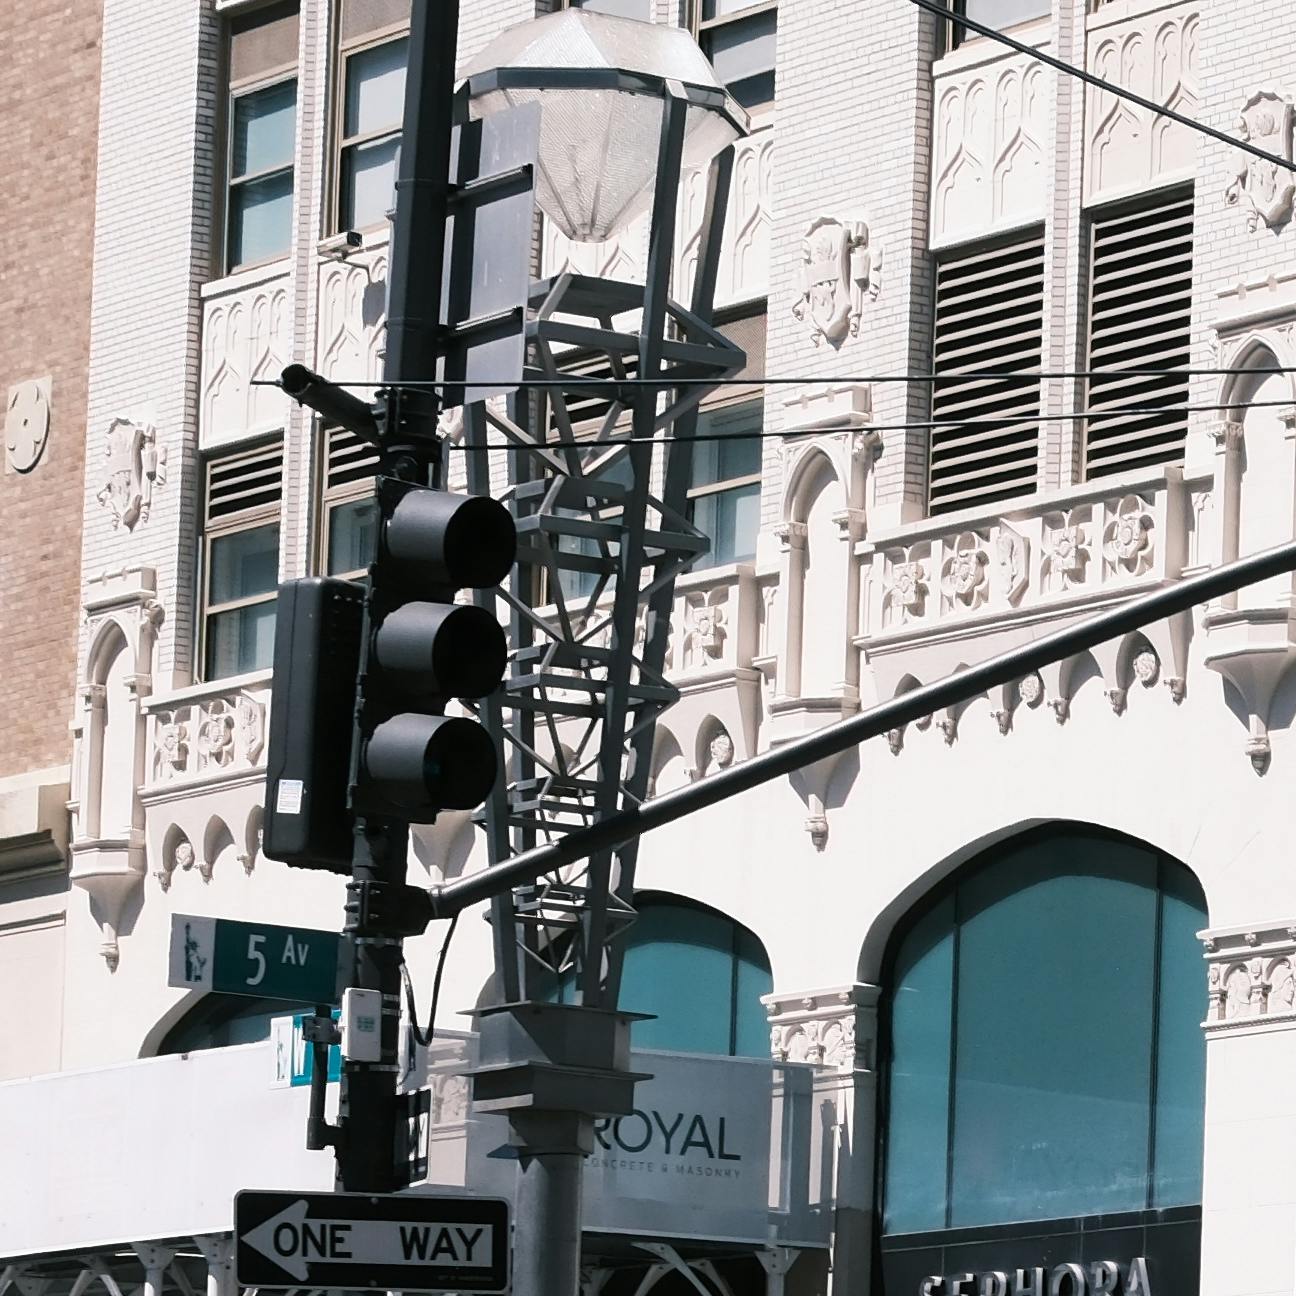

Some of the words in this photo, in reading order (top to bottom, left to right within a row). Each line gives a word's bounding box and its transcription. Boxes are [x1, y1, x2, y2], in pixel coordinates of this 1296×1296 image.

[246, 934, 267, 986] 5
[281, 934, 310, 967] Av
[676, 1164, 741, 1180] MASONRY
[273, 1222, 352, 1259] ONE
[399, 1225, 483, 1262] WAY
